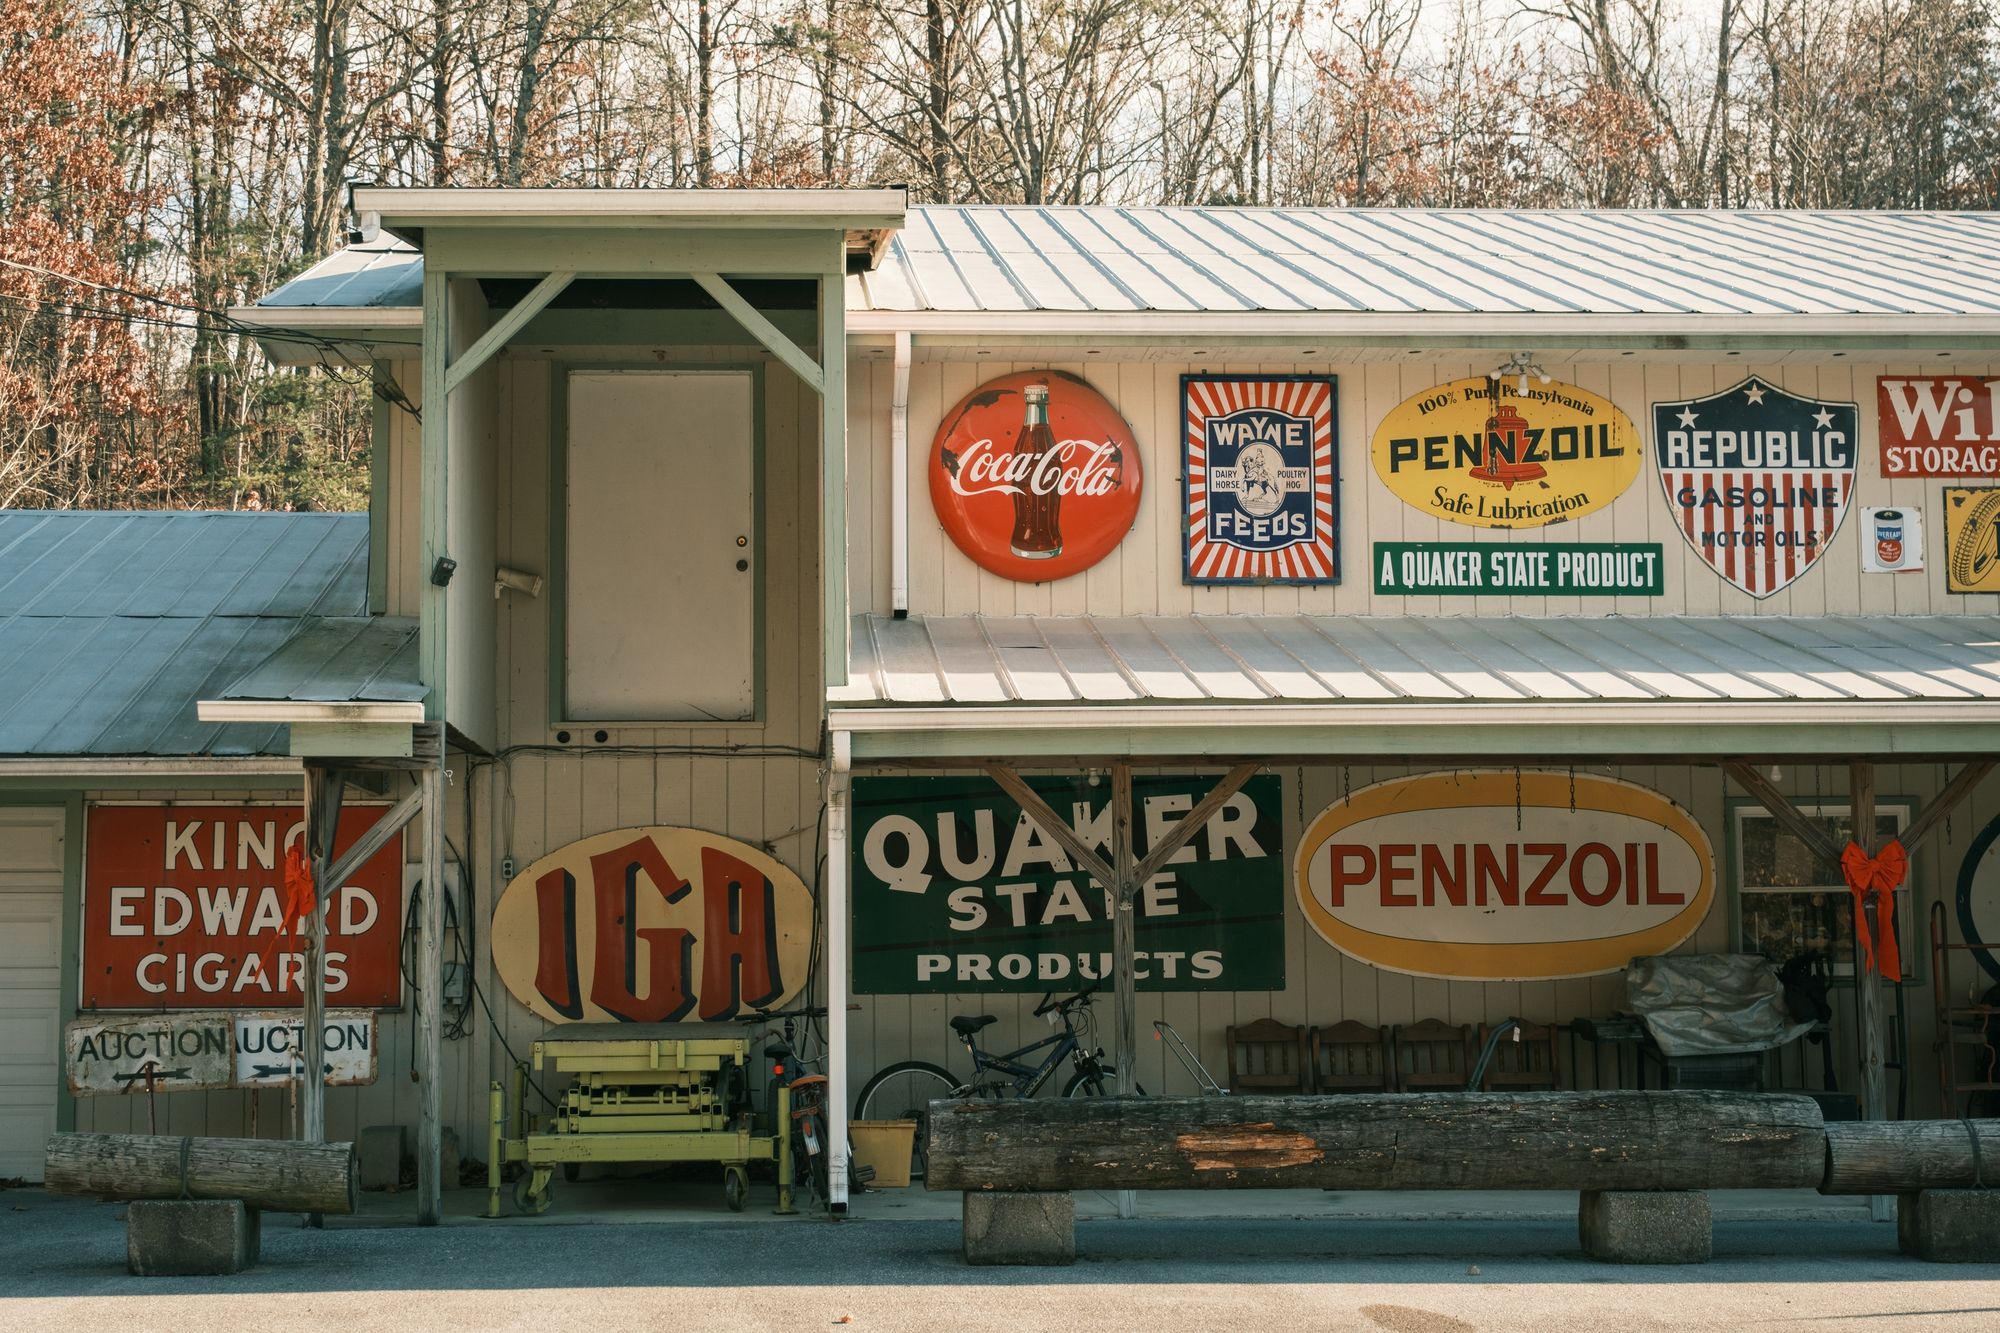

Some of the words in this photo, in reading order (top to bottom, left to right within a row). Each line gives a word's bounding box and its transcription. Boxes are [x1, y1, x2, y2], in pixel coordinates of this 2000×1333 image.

[1417, 391, 1457, 415] 100%
[1464, 387, 1492, 401] Pur
[1502, 384, 1595, 417] Pensylvania
[1213, 416, 1304, 449] WAYNE
[1390, 424, 1624, 473] PENNZOIL
[1667, 431, 1846, 467] REPUBLIC
[950, 439, 1122, 496] Coca-Cola
[1215, 470, 1237, 479] DAIRY
[1277, 470, 1307, 479] POULTRY
[1886, 446, 2000, 473] STORAG
[1215, 480, 1240, 489] HORSE
[1286, 480, 1301, 489] HOG
[1677, 487, 1839, 508] GASOLINE
[1431, 486, 1473, 516] Safe
[1477, 492, 1590, 520] Lubrication
[1743, 514, 1774, 525] AND
[1215, 508, 1307, 541] FEEDS
[1701, 531, 1765, 547] MOTOR
[1775, 531, 1818, 547] OILS
[1380, 551, 1395, 586] A
[1402, 551, 1483, 588] QUAKER
[1491, 552, 1550, 587] STATE
[1557, 552, 1656, 587] PRODUCT
[1330, 842, 1685, 907] PENNZOIL
[534, 836, 785, 1022] IGA
[77, 1027, 226, 1062] AUCTION
[236, 1024, 369, 1054] UCTON
